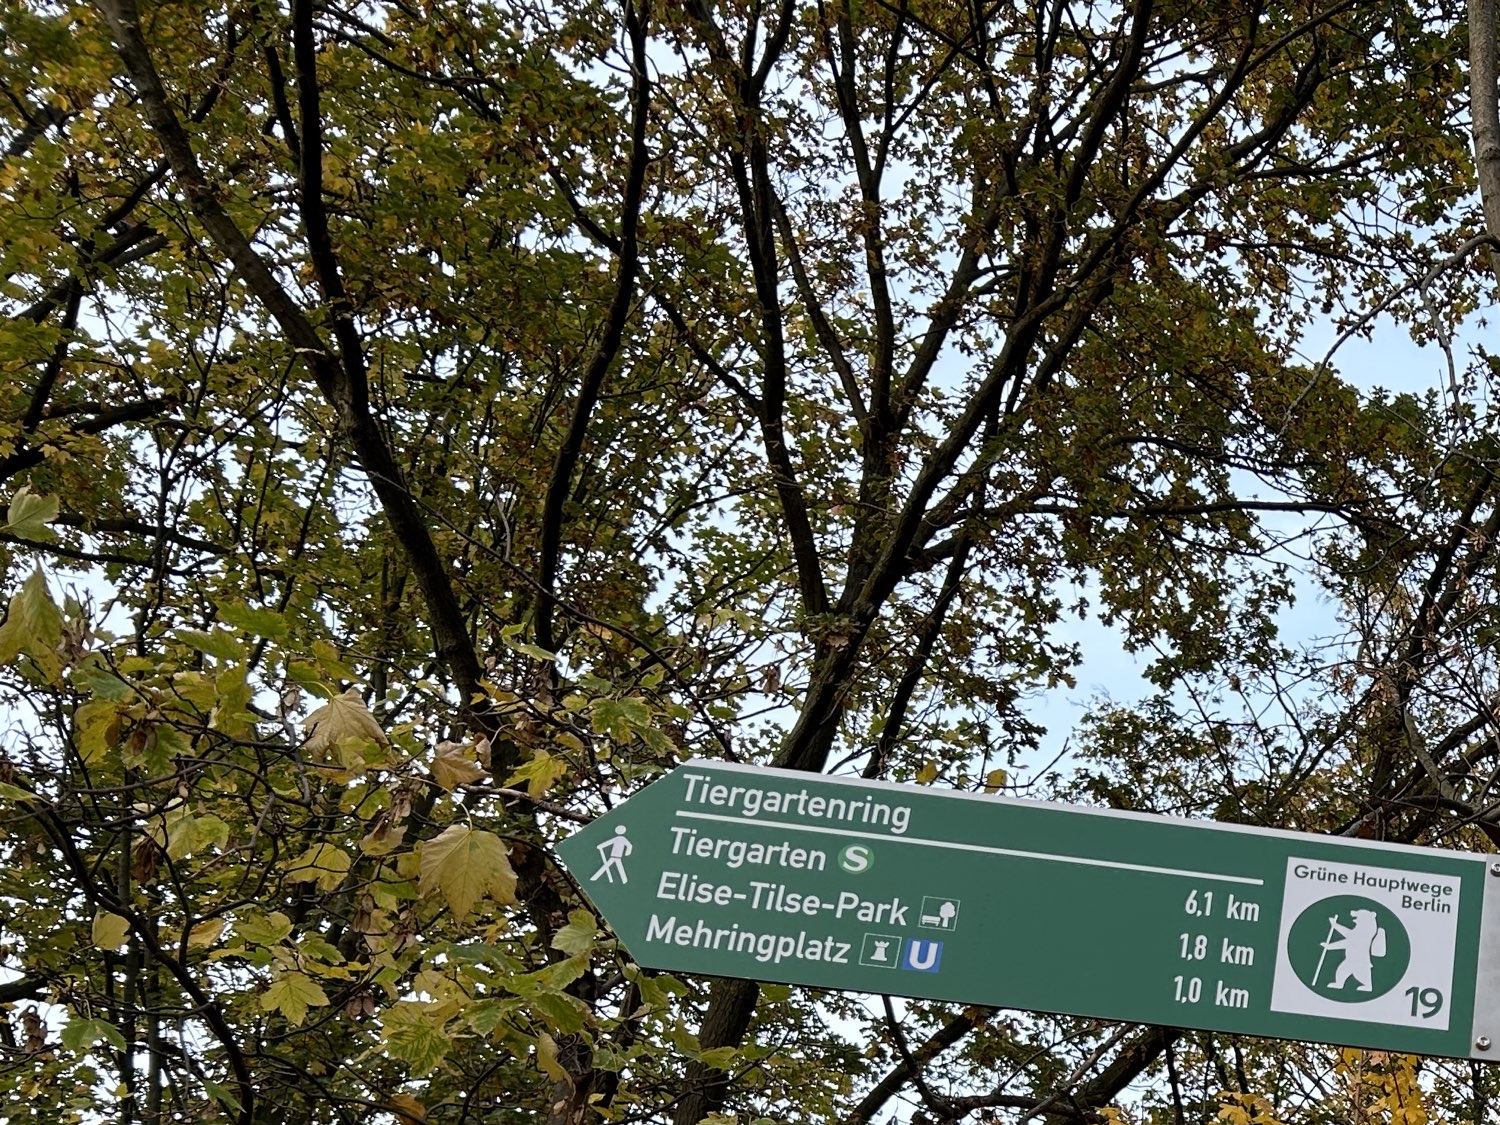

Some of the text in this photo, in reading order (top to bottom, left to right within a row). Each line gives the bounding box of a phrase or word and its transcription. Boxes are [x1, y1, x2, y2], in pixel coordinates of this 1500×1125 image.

[683, 774, 911, 834] Tiergartenring
[671, 827, 868, 871] Tiergarten S
[1295, 865, 1452, 896] Grüne Hauptwege
[657, 872, 909, 925] Elise-Tilse-Park
[1186, 890, 1259, 921] 6,1 km
[1402, 895, 1450, 913] Berlin
[646, 914, 938, 969] Mehringplatz U
[1181, 934, 1254, 965] 1,8 km
[1175, 976, 1248, 1008] 1,0 km
[1405, 987, 1443, 1018] 19
